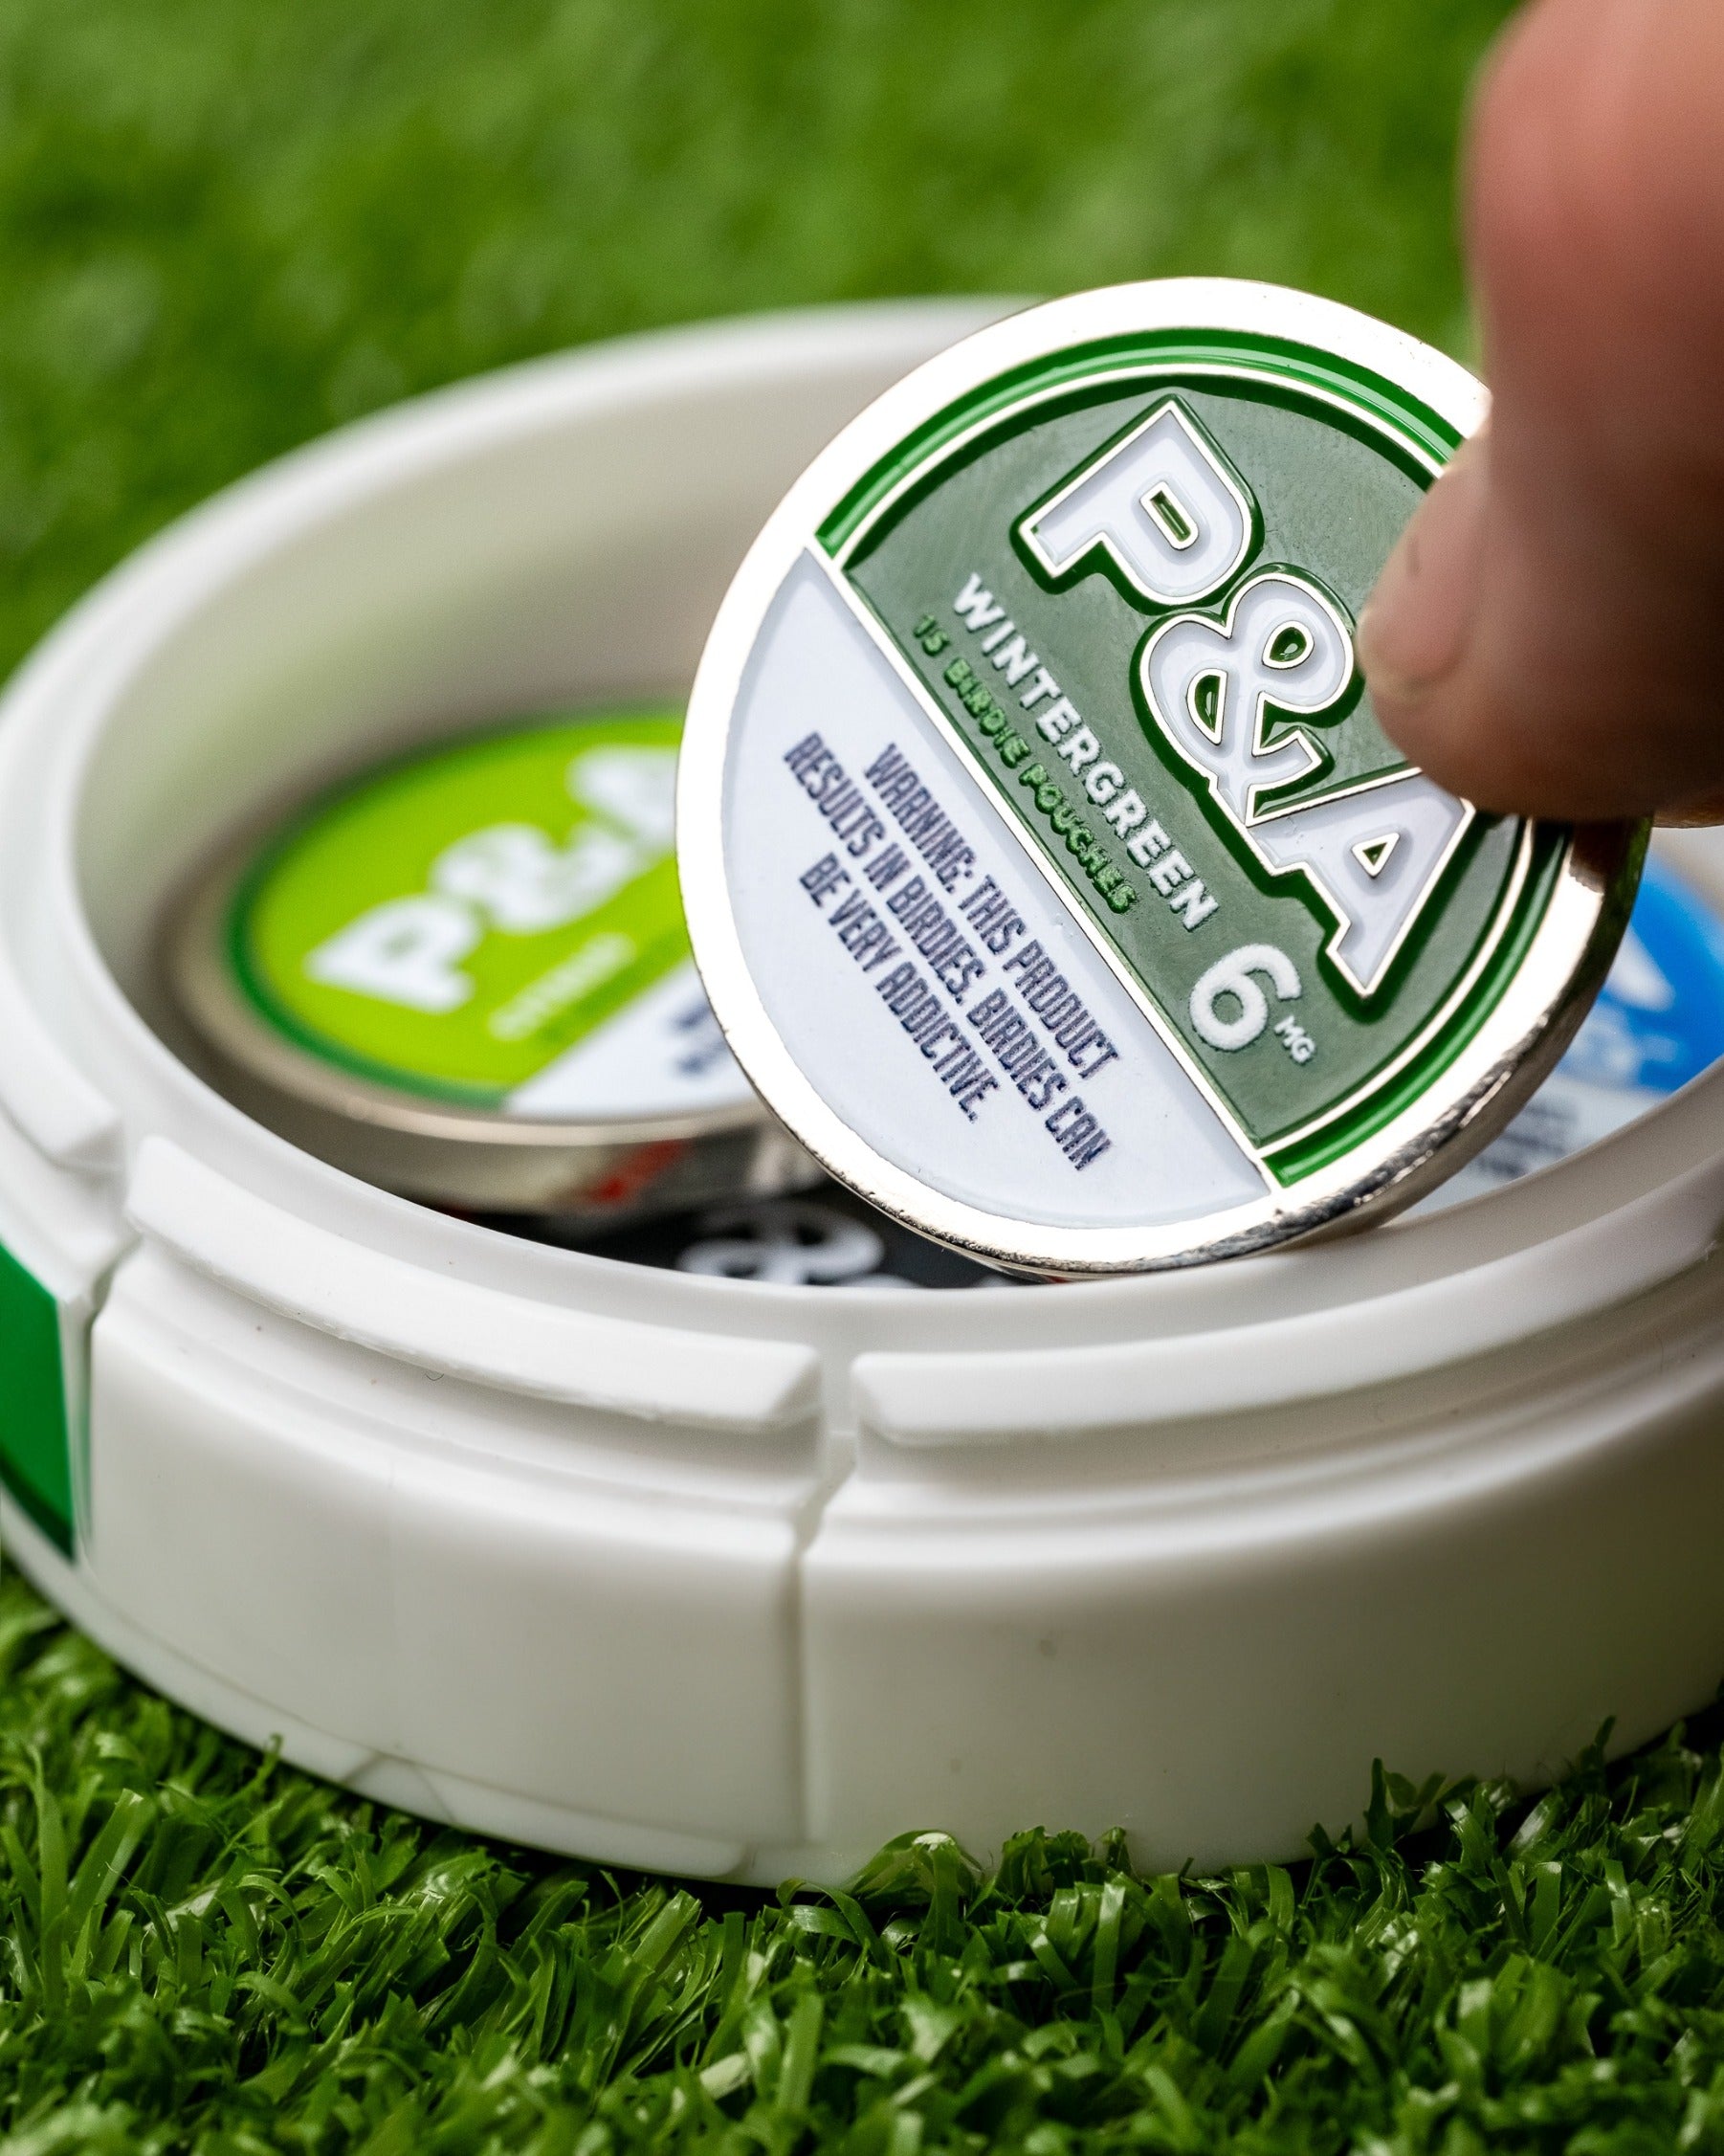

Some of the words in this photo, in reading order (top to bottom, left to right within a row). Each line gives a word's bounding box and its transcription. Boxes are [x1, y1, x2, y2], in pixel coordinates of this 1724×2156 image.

[914, 613, 950, 656] 15
[944, 657, 1030, 767] BIRDIE
[1019, 764, 1138, 914] POUCHES
[955, 572, 1219, 931] WINTERGREEN
[1020, 400, 1475, 998] P&A
[784, 731, 886, 857] RESULTS
[863, 843, 911, 891] IN
[864, 743, 976, 894] WARNING:
[958, 875, 1026, 956] THIS
[1003, 939, 1118, 1079] PRODUCT
[799, 852, 851, 907] BE
[829, 889, 902, 973] VERY
[874, 961, 1001, 1122] ADDICTIVE.
[886, 876, 984, 1006] BIRDIES.
[1189, 943, 1302, 1052] 6
[1273, 1014, 1315, 1064] MG
[966, 988, 1068, 1111] BIRDIES
[1046, 1096, 1112, 1171] CAN
